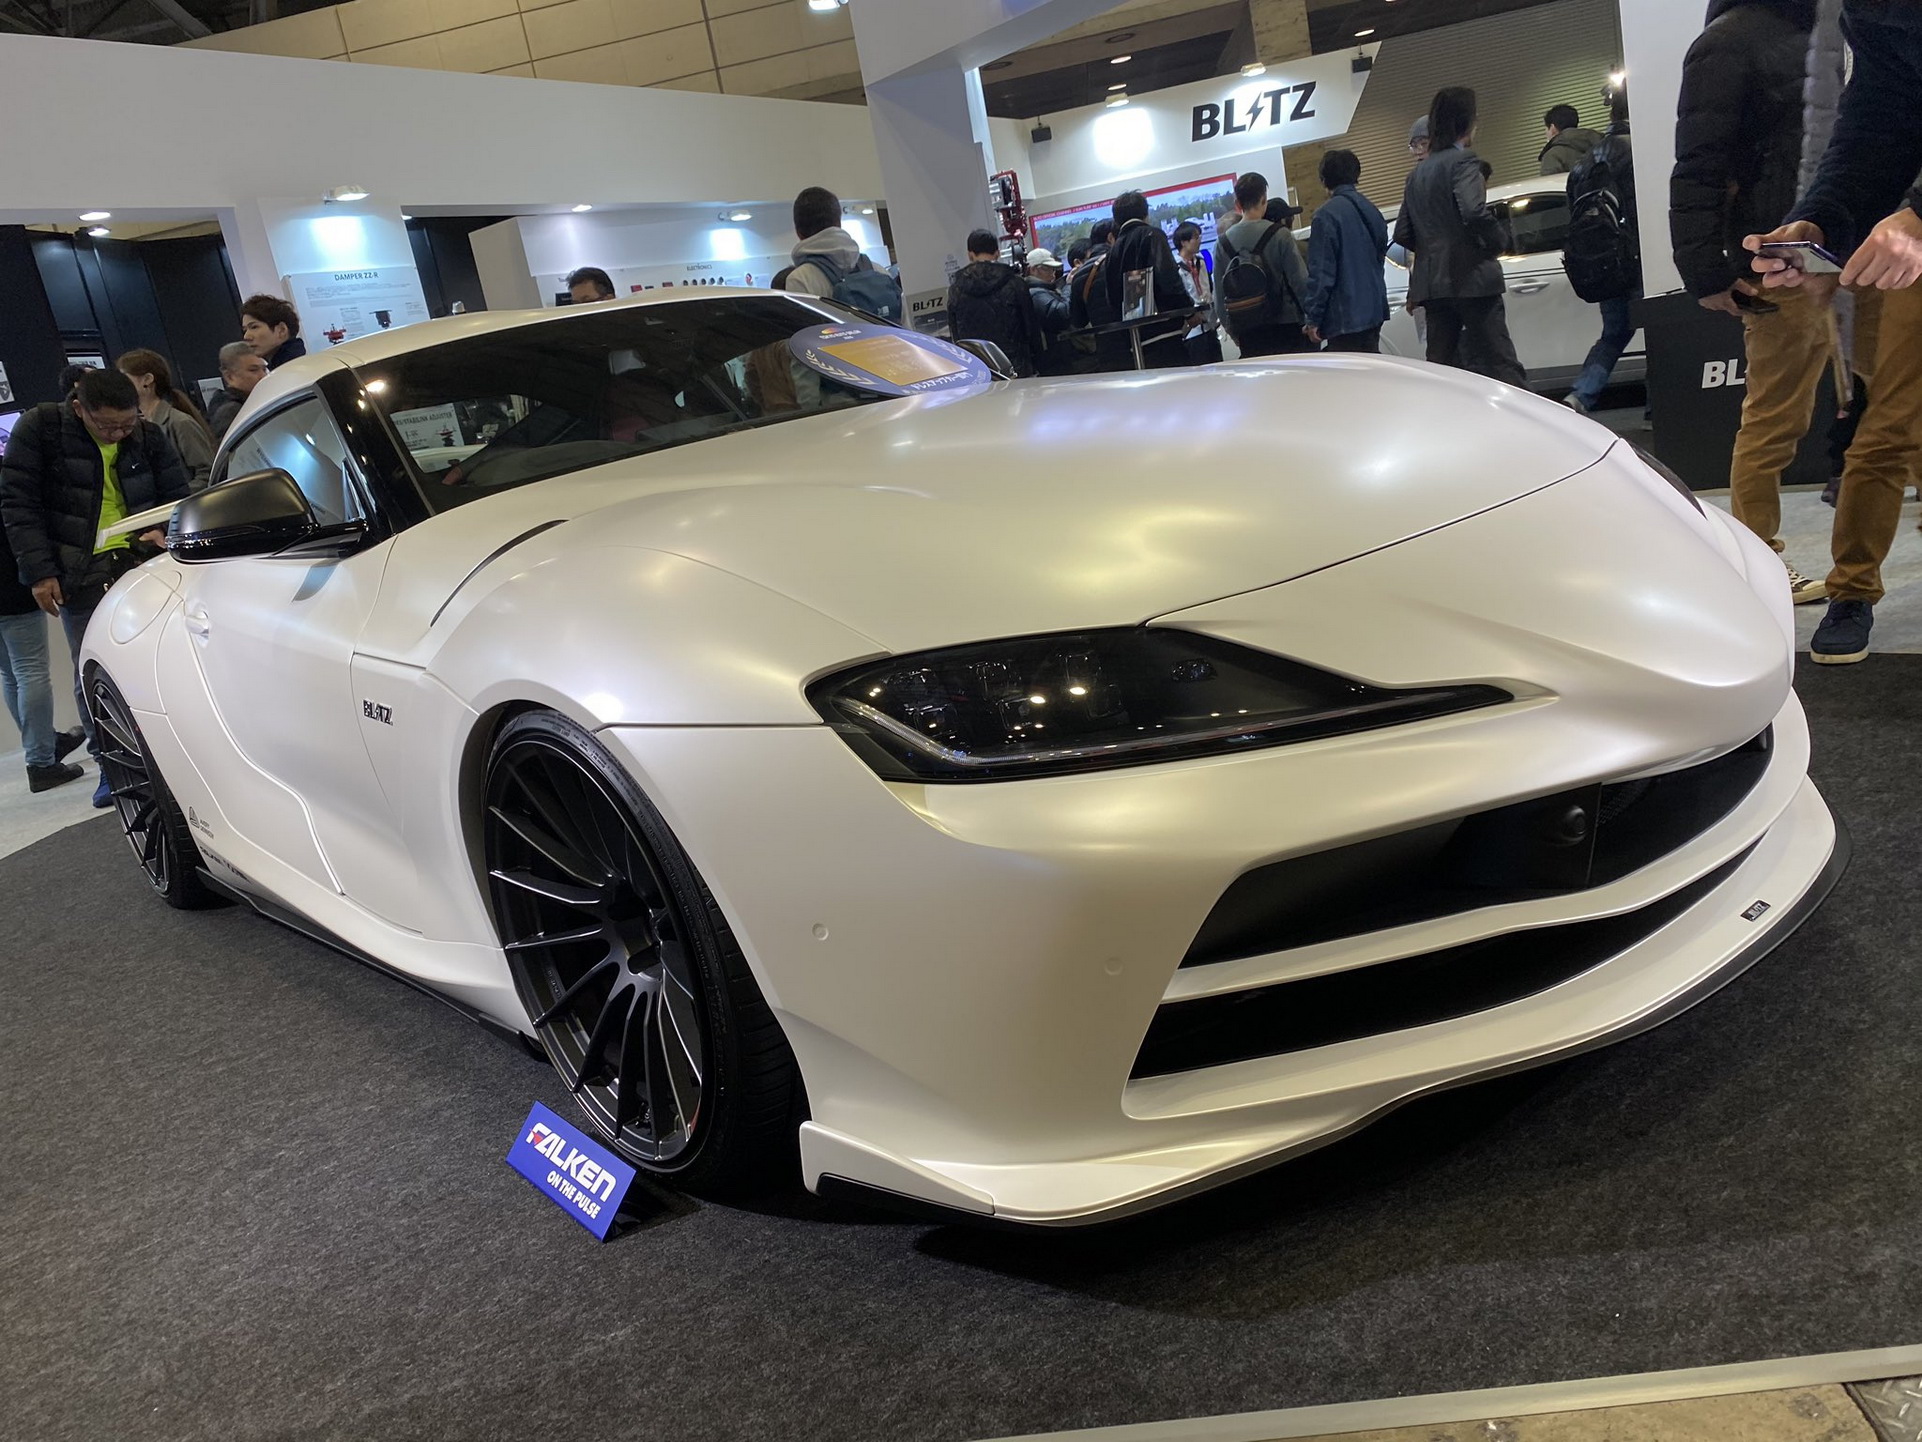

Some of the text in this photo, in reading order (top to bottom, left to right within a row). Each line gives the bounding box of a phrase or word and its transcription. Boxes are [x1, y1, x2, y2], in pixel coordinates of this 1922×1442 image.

[1192, 81, 1317, 142] BLITZ
[334, 272, 363, 281] DAMPER
[912, 296, 943, 311] BLITZ
[1701, 358, 1747, 389] BL
[363, 699, 394, 727] BLITZ
[525, 1122, 617, 1202] FALKEN
[546, 1170, 602, 1220] ON THE PULSE
